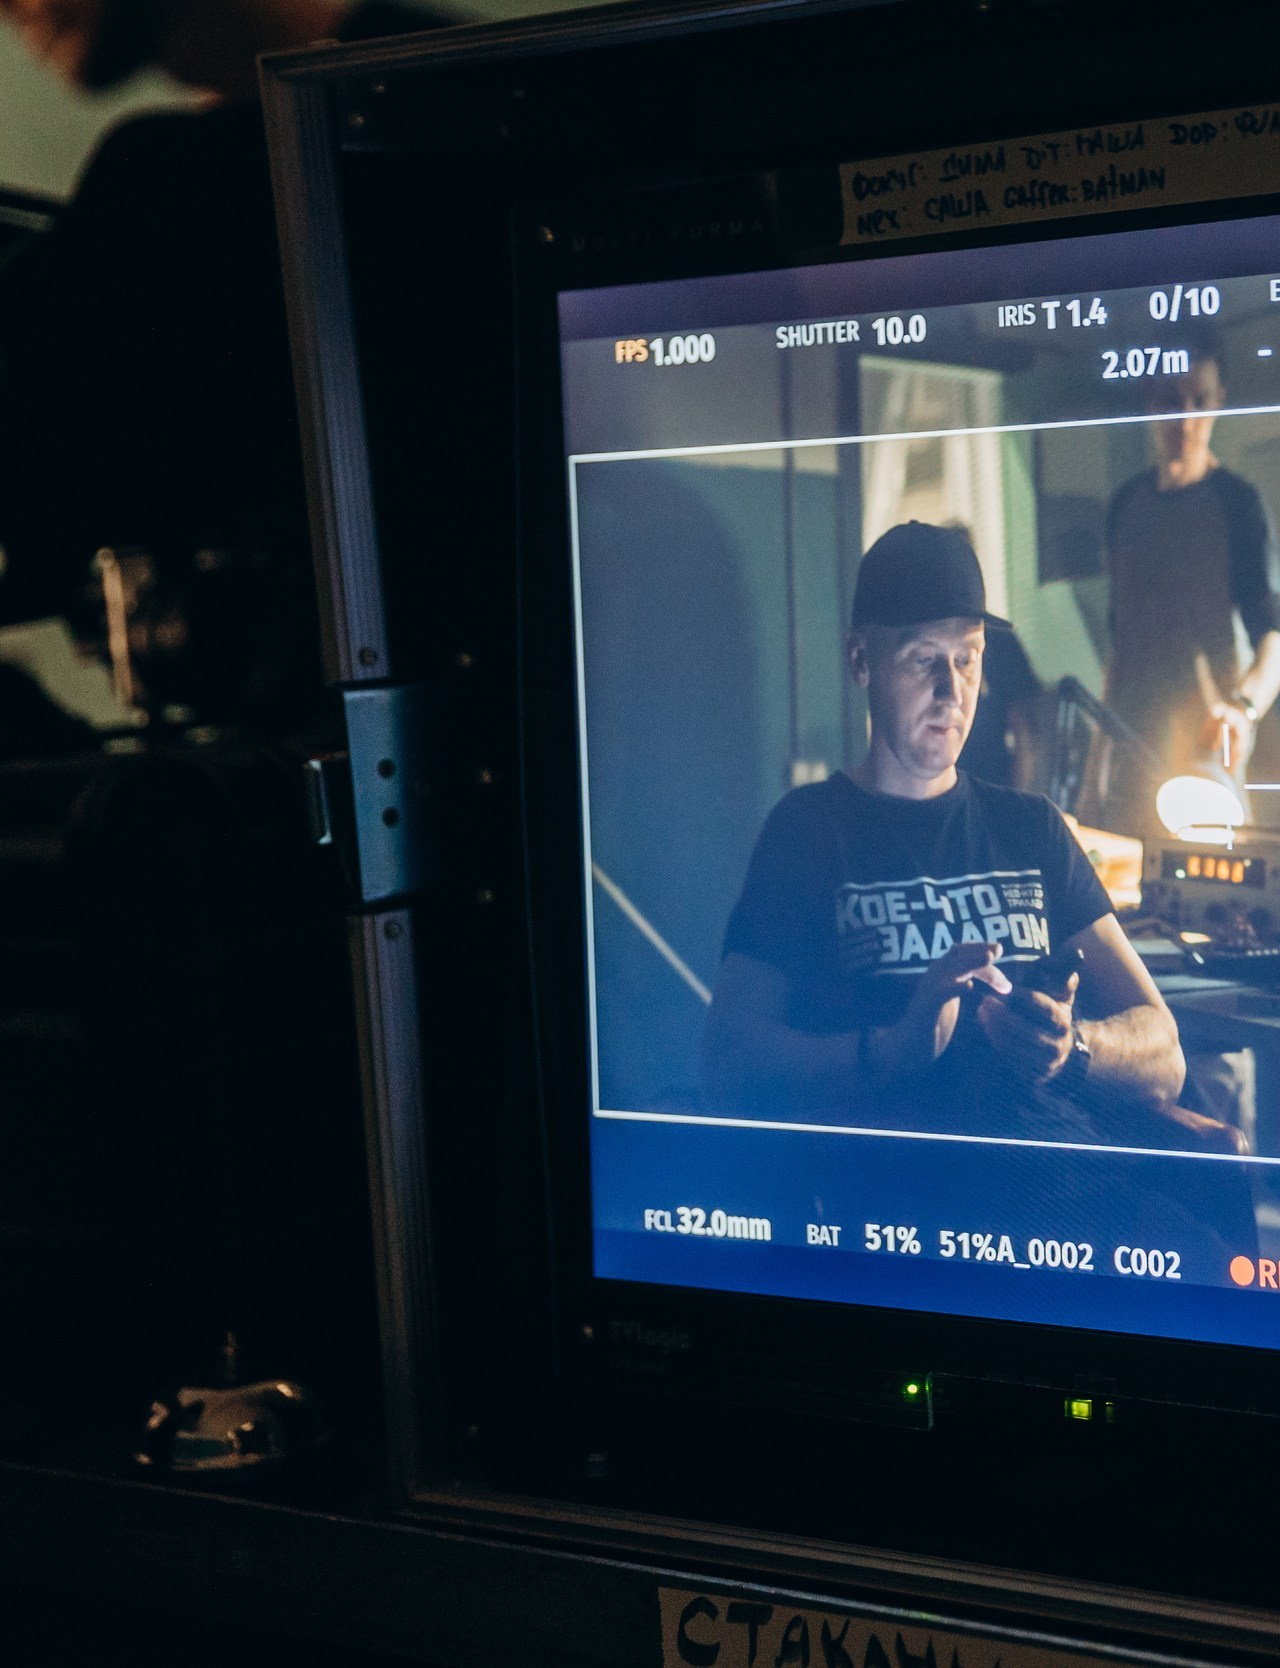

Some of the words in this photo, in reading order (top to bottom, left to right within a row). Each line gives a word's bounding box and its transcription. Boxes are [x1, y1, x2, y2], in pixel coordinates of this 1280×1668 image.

[997, 303, 1037, 328] IRIS
[1065, 297, 1107, 327] 1.4
[1149, 285, 1221, 322] 0/10
[775, 320, 860, 349] SHUTTER
[871, 314, 927, 346] 10.0
[614, 339, 648, 364] FPS
[649, 333, 716, 366] 1.000
[1101, 347, 1189, 379] 2.07m
[836, 884, 1001, 934] КОЕ-ЧТО
[676, 1206, 771, 1241] 32.0mm
[807, 1224, 841, 1246] BAT
[865, 1223, 921, 1255] 51%
[1114, 1245, 1181, 1279] C002
